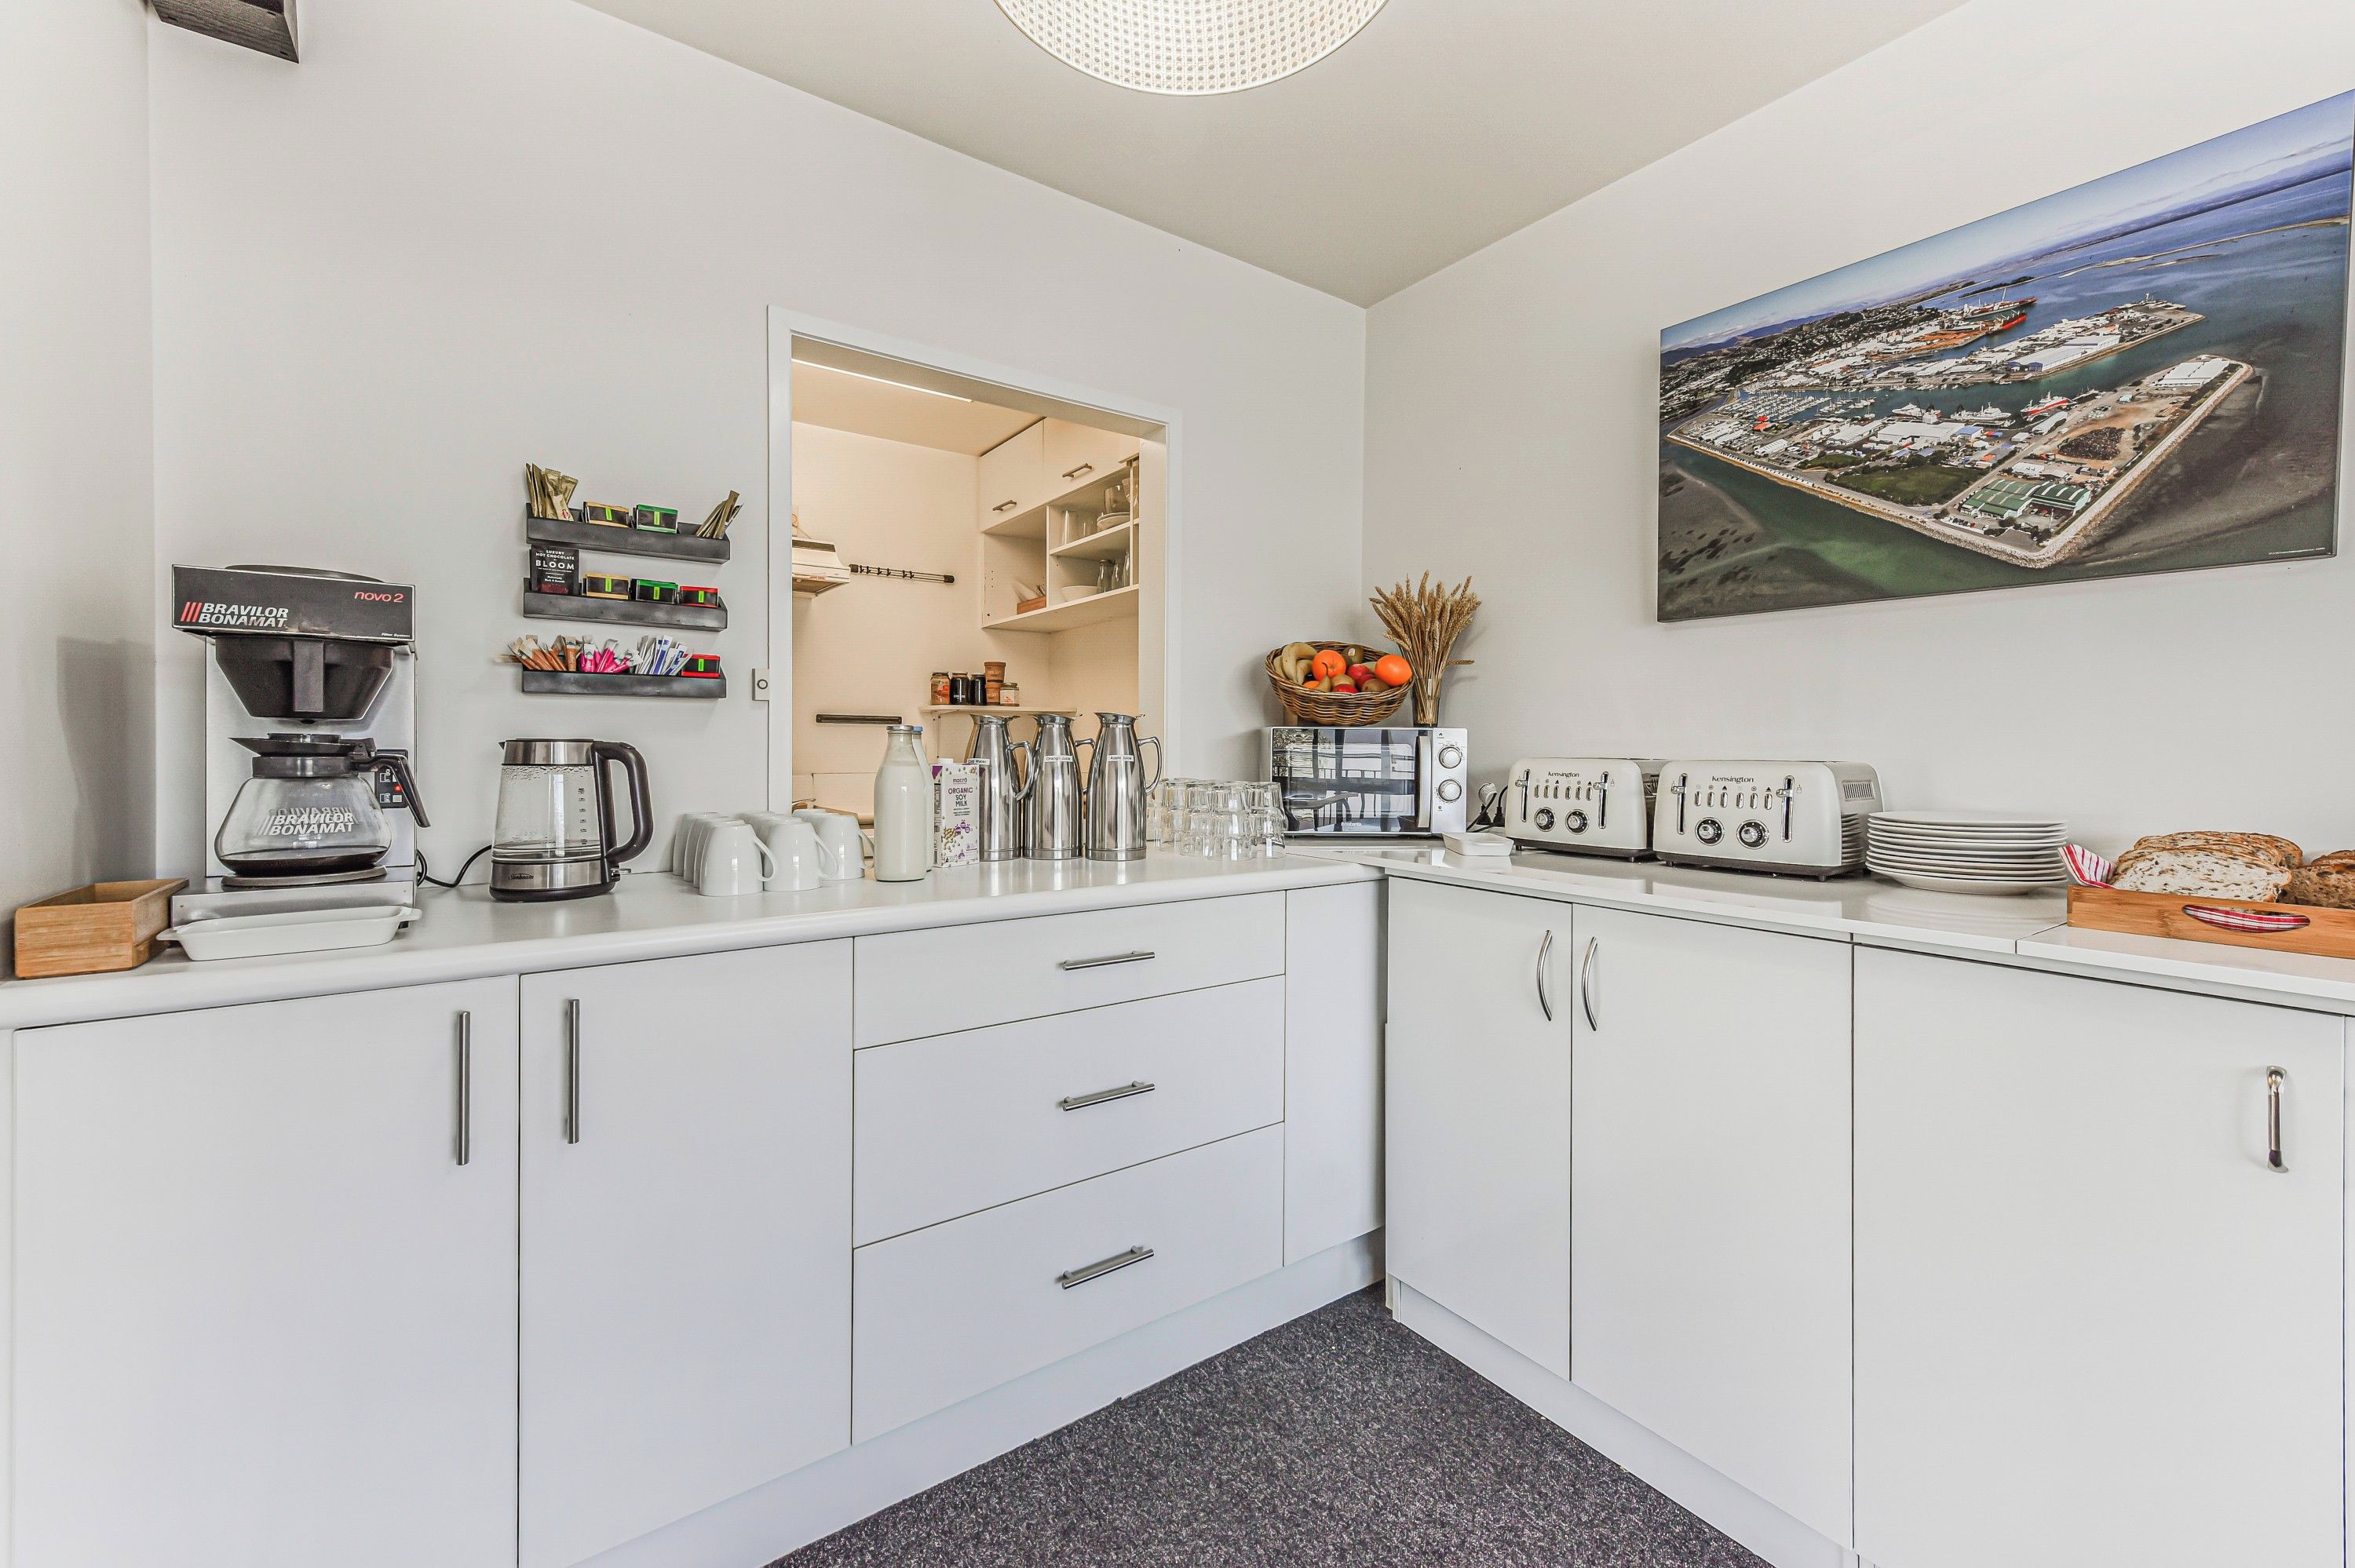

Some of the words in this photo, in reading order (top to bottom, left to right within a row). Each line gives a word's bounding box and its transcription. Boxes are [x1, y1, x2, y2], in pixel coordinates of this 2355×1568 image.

[535, 560, 575, 570] BLOOM
[202, 603, 289, 618] BRAVILOR
[198, 613, 287, 628] BONAMAT
[273, 813, 354, 826] BRAVILOR
[268, 822, 354, 836] BONAMAT
